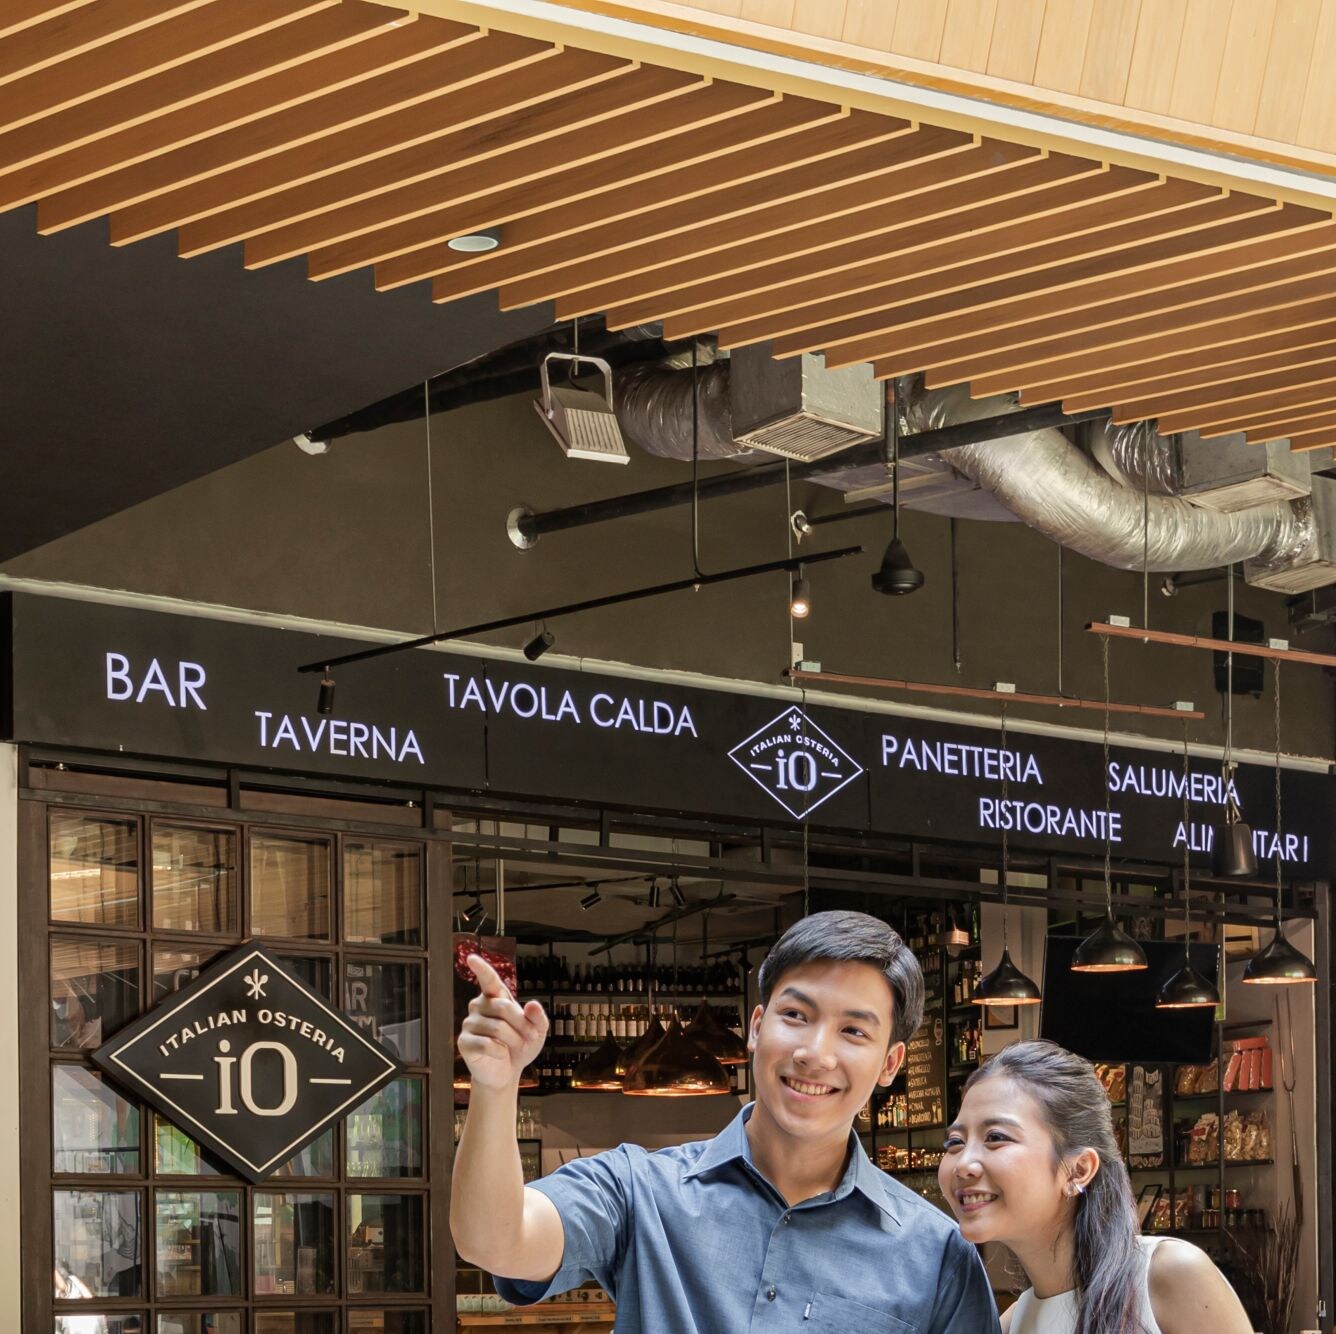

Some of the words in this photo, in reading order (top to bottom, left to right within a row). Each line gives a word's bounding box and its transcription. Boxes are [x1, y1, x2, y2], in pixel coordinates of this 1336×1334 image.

[105, 651, 208, 711] BAR
[443, 672, 581, 724] TAVOLA
[589, 693, 699, 738] CALDA
[254, 710, 425, 765] TAVERNA
[749, 734, 792, 757] ITALIAN
[795, 734, 840, 768] OSTERIA
[881, 734, 1043, 785] PANETTERIA
[1107, 761, 1241, 807] SALUMERIA
[978, 797, 1122, 843] RISTORANTE
[1172, 820, 1309, 863] ALITARI
[159, 1009, 247, 1057] ITALIAN
[257, 1008, 346, 1064] OSTERIA
